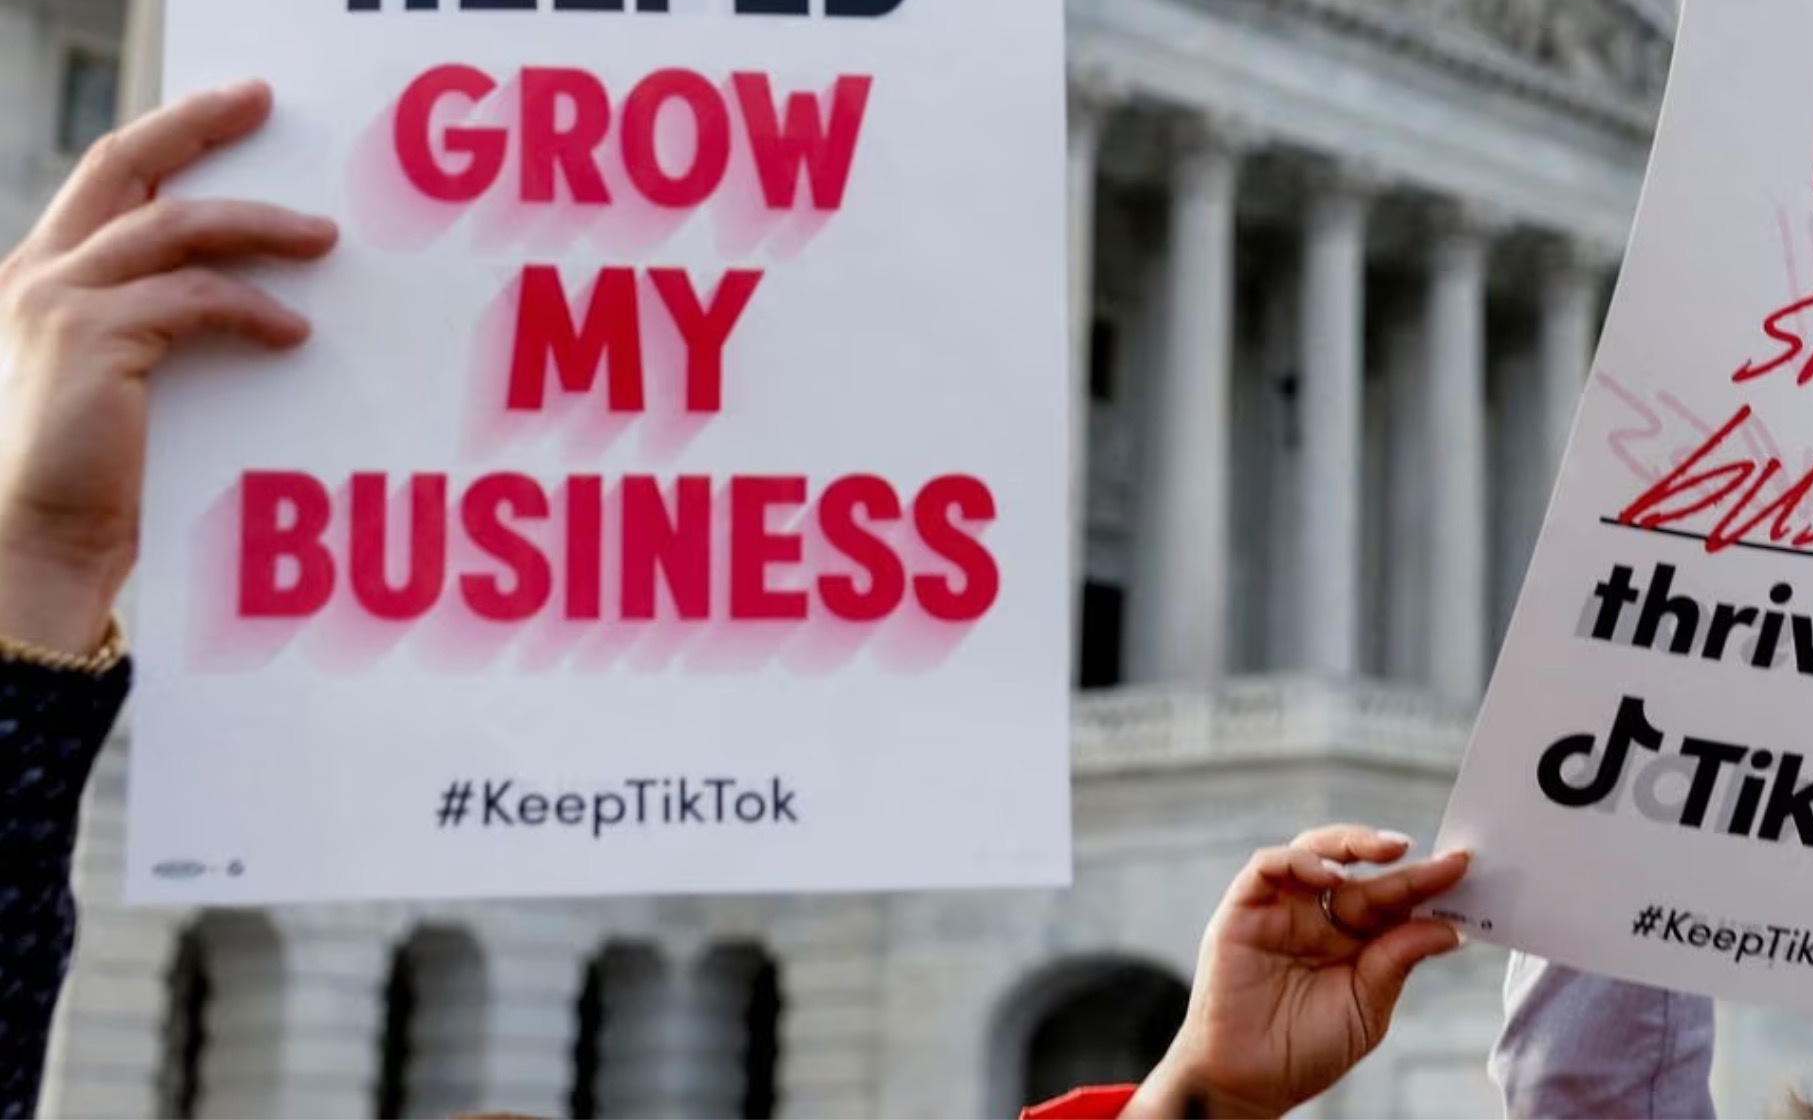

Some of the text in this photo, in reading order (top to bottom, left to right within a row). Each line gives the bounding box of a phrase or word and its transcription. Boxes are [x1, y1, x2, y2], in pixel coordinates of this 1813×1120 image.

[394, 64, 873, 211] GROW
[505, 265, 765, 414] MY
[238, 470, 1000, 623] BUSINESS
[436, 776, 798, 839] #KeepTikTok
